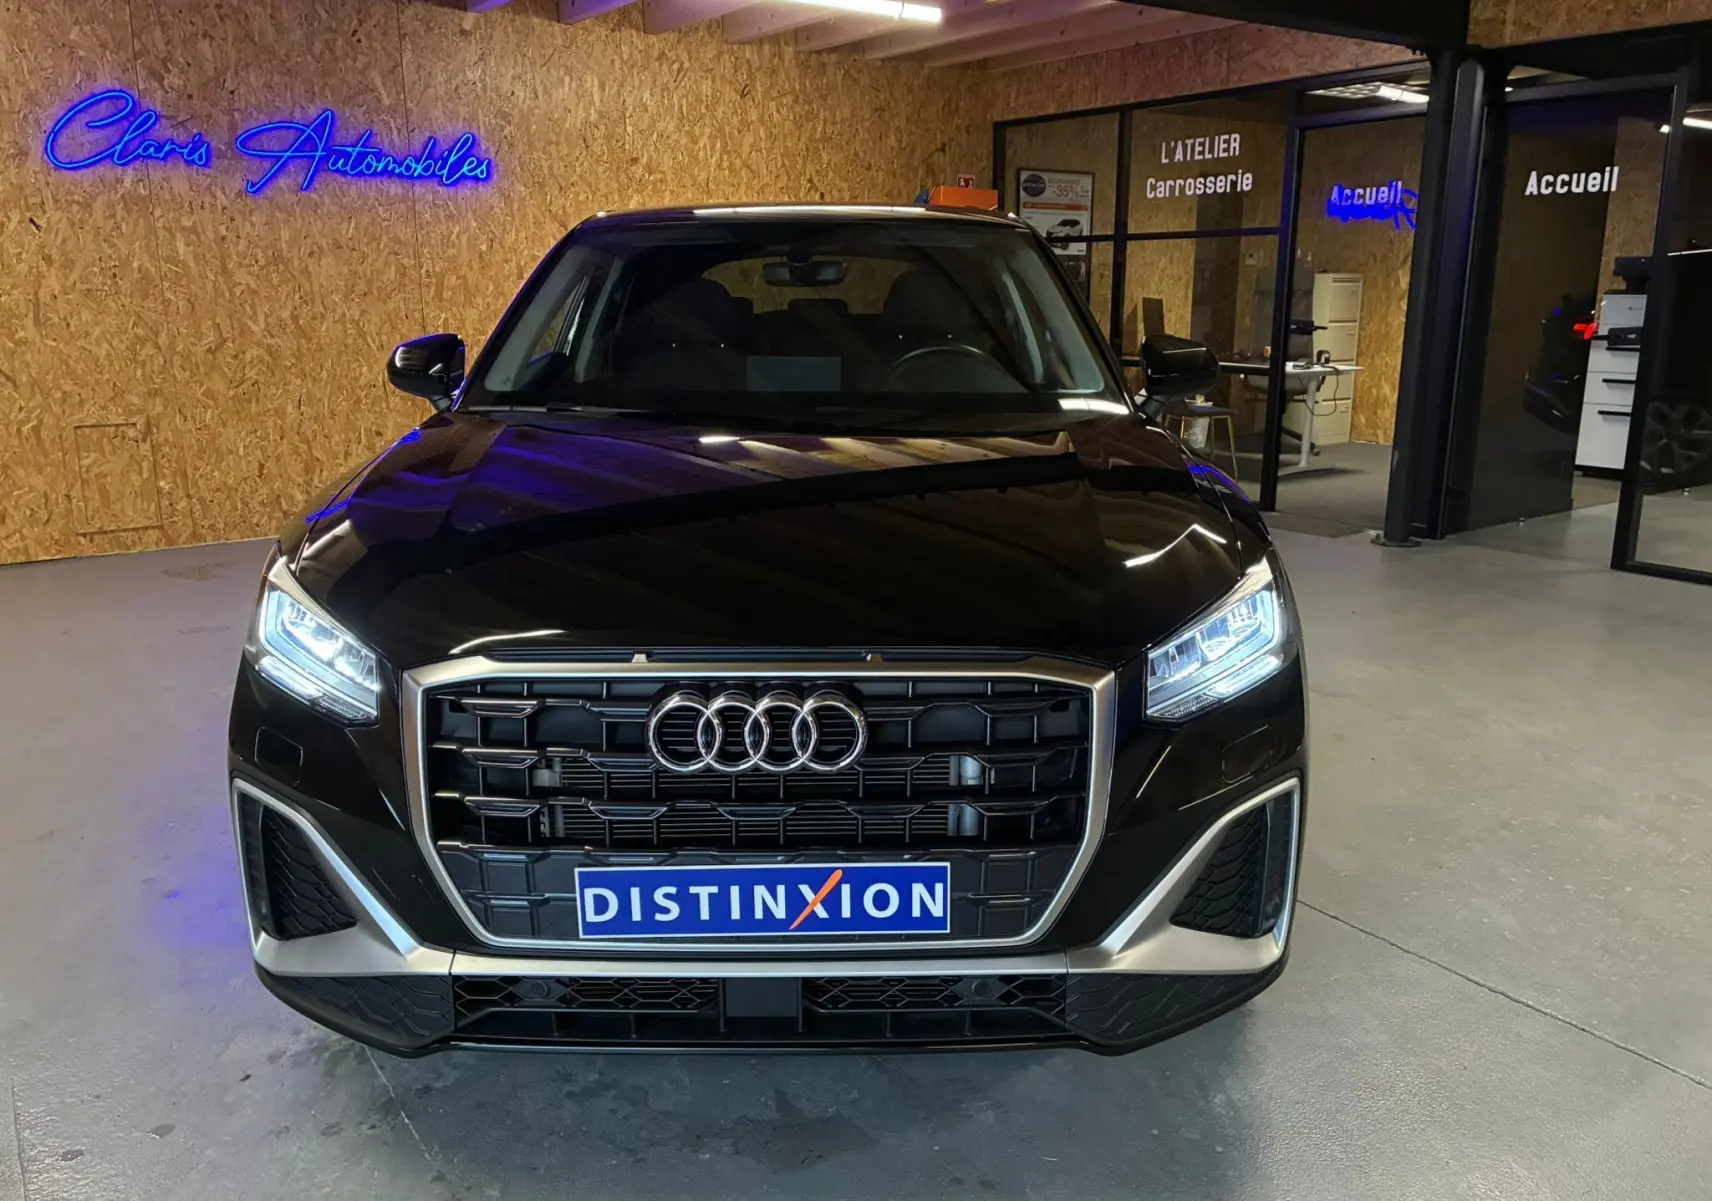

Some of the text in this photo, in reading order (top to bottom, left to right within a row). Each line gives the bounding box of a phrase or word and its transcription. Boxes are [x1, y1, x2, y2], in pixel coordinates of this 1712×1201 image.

[46, 90, 490, 194] Claris Automobiles
[1161, 133, 1240, 163] L'ATELIER
[1146, 169, 1252, 198] Carrosserie
[1331, 180, 1402, 206] Accueil
[1524, 166, 1619, 195] Accueil
[583, 869, 944, 930] DISTINXION
